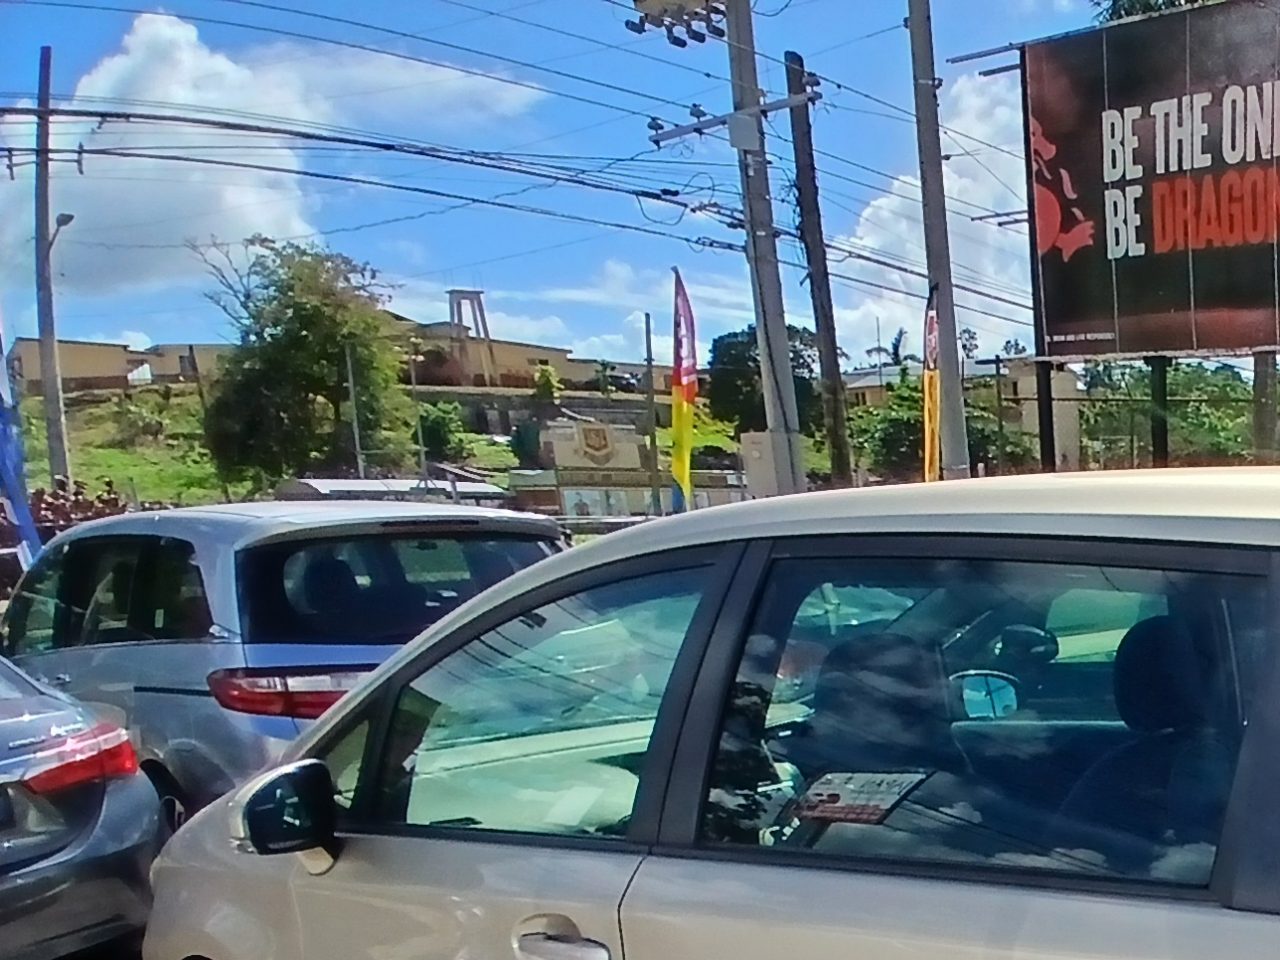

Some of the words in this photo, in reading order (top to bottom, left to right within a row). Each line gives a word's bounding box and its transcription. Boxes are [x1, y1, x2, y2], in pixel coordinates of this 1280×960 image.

[1101, 106, 1143, 183] BE
[1150, 92, 1212, 174] THE
[1104, 185, 1145, 260] BE
